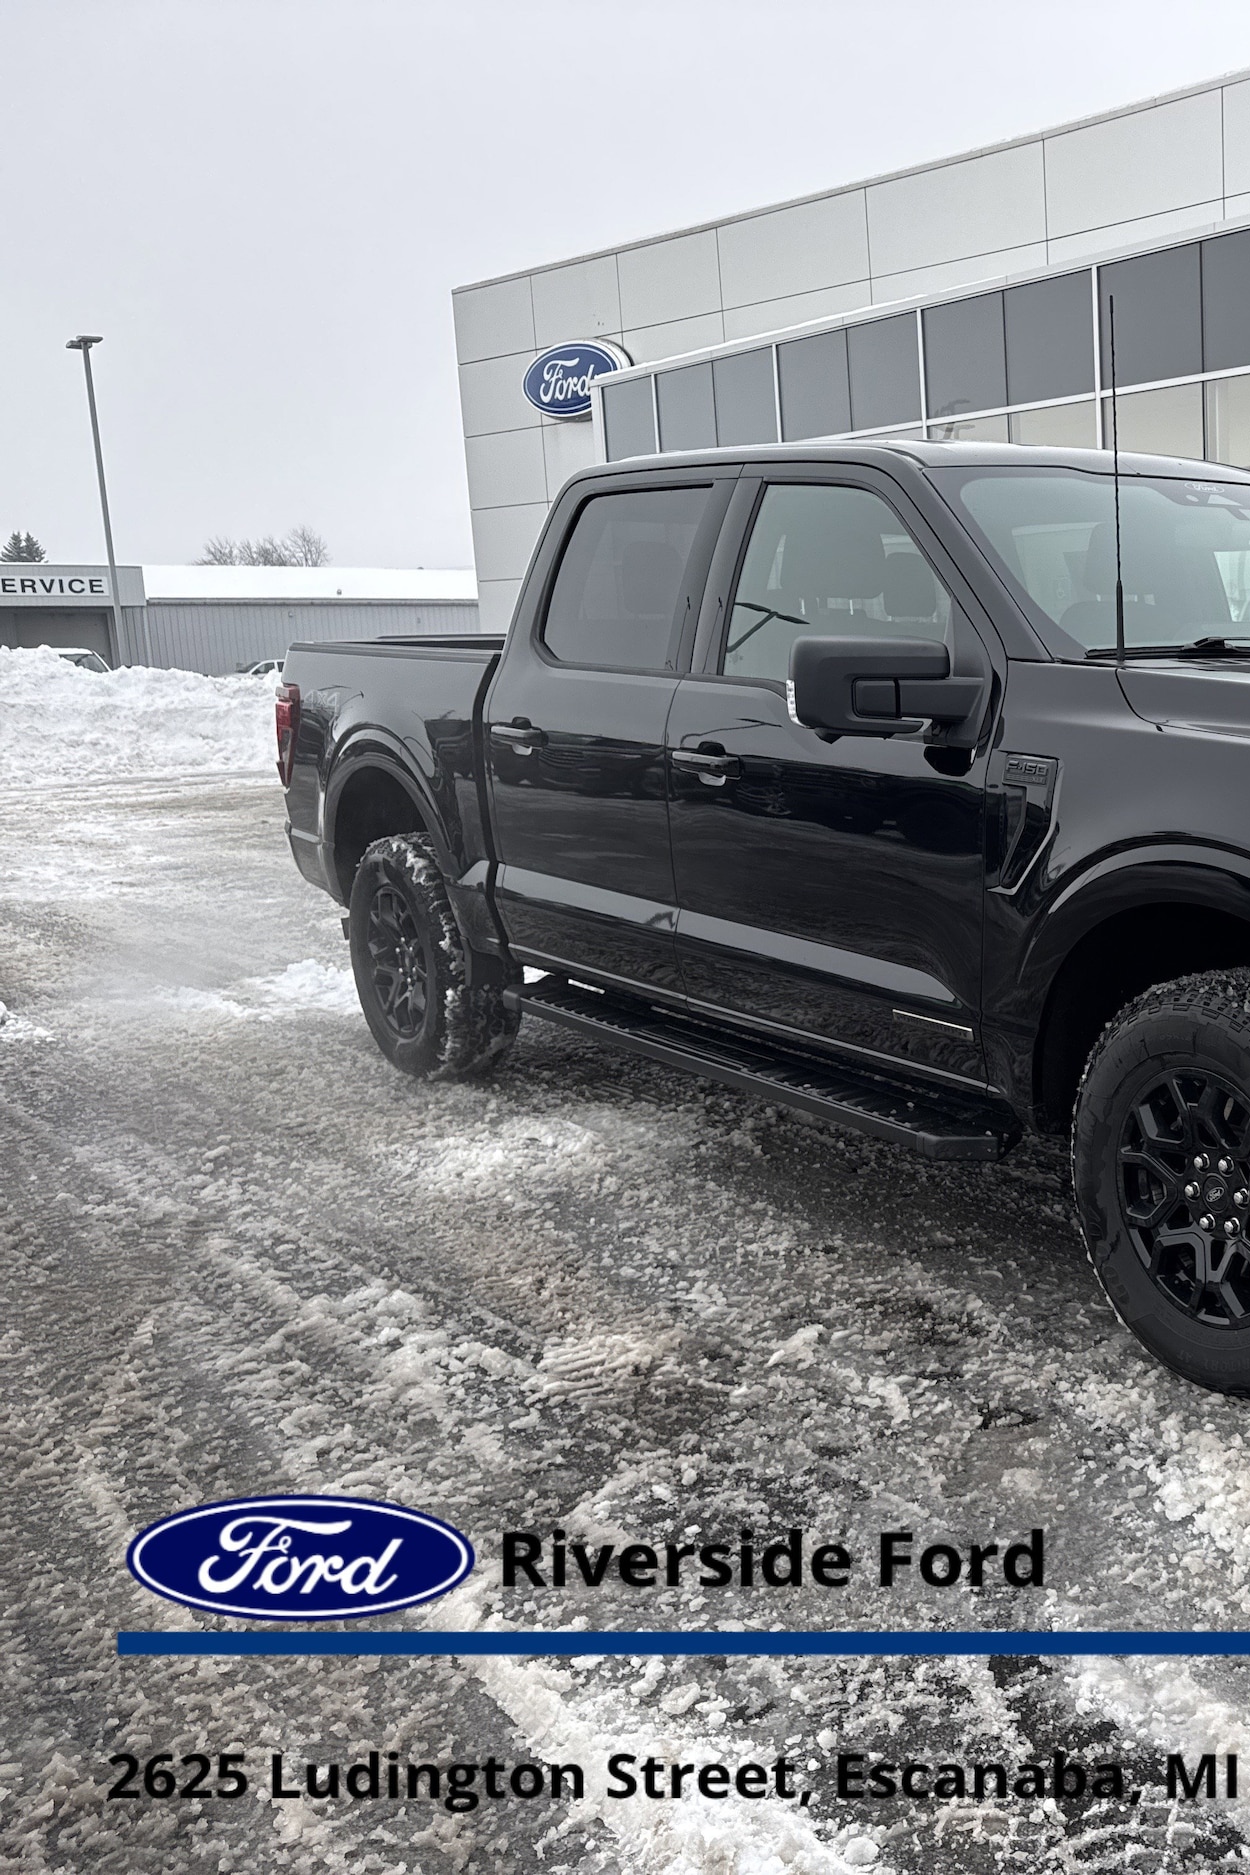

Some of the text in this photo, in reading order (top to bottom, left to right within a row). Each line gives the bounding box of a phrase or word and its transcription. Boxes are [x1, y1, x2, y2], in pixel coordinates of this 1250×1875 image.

[540, 357, 595, 403] Ford
[1, 578, 105, 594] ERVICE
[1006, 760, 1049, 776] F-150
